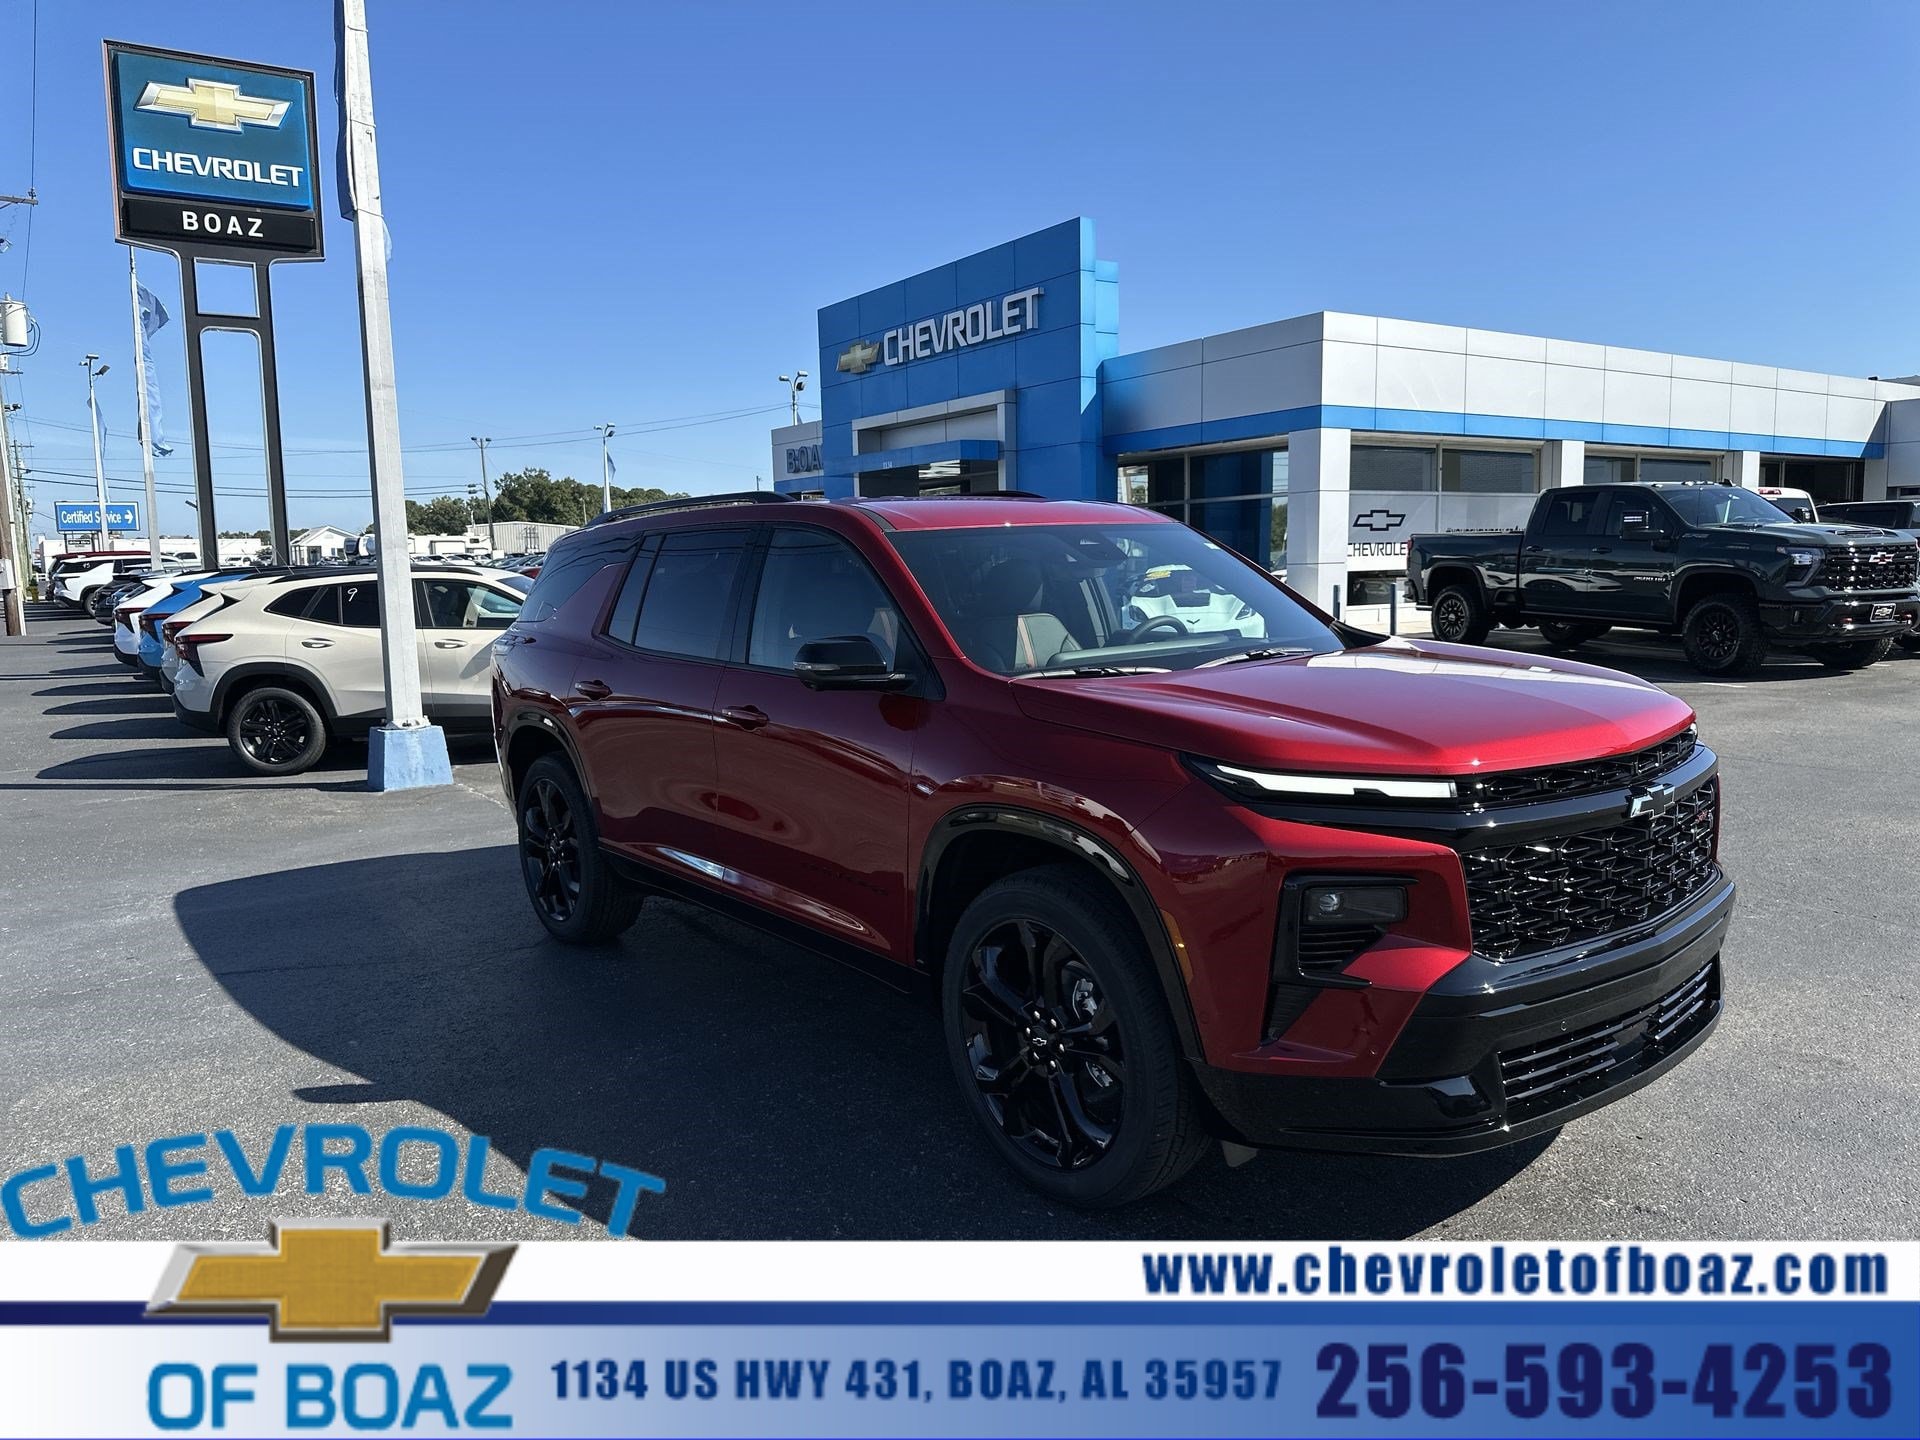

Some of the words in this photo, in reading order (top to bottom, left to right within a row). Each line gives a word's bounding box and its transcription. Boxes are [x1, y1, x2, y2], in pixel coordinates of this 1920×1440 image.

[132, 147, 304, 187] CHEVROLET
[182, 211, 264, 238] BOAZ
[883, 287, 1040, 366] CHEVROLET
[786, 444, 824, 474] BOA
[61, 509, 93, 524] Certified
[94, 510, 122, 524] Svice
[1347, 542, 1407, 557] HEVROLE
[347, 587, 358, 602] 9
